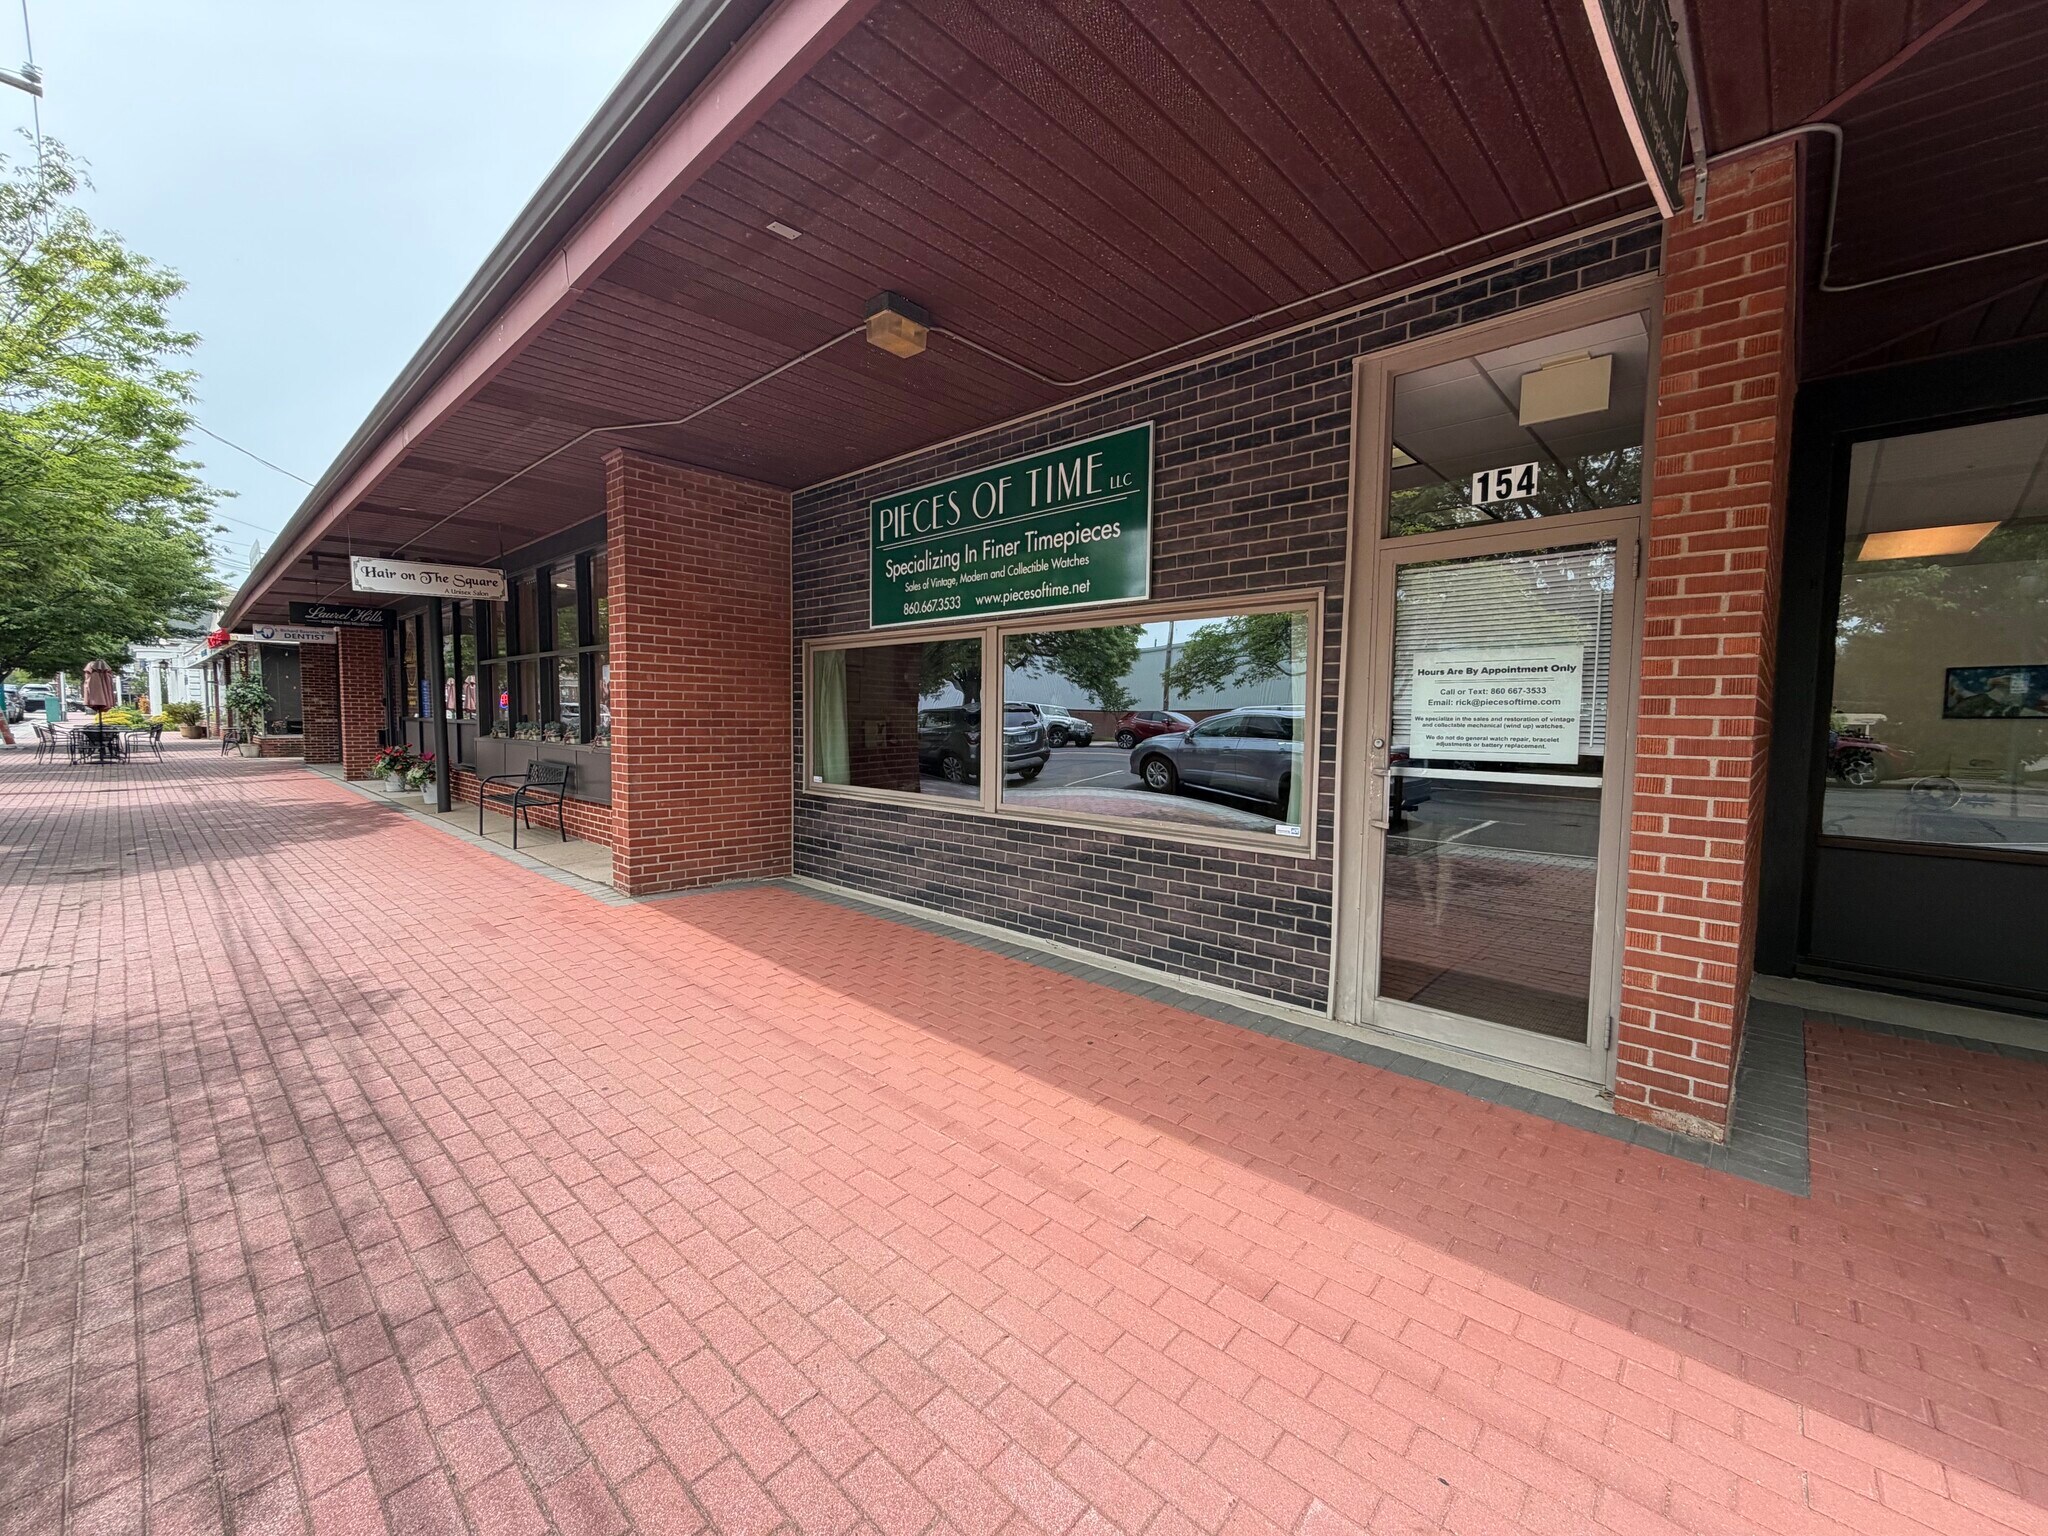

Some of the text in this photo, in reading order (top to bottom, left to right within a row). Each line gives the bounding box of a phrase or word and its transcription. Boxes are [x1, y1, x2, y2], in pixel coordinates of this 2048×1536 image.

[880, 452, 1132, 541] PIECES OF TIME LLC
[1477, 465, 1535, 502] 154
[885, 522, 1121, 582] Specializing In Finer Timepieces
[361, 566, 499, 589] Hair on The Square
[904, 556, 1089, 593] Sales of Vintage, Modern and Collectible Watches
[451, 588, 471, 596] Unisex
[903, 580, 1090, 616] 860.667.3533 www.piecesoftime.net
[305, 606, 384, 622] Laurel Hills
[1466, 667, 1479, 678] By
[1481, 665, 1548, 676] Appointment
[1551, 664, 1577, 673] Only
[1455, 698, 1561, 708] rick@piecesoftime.com
